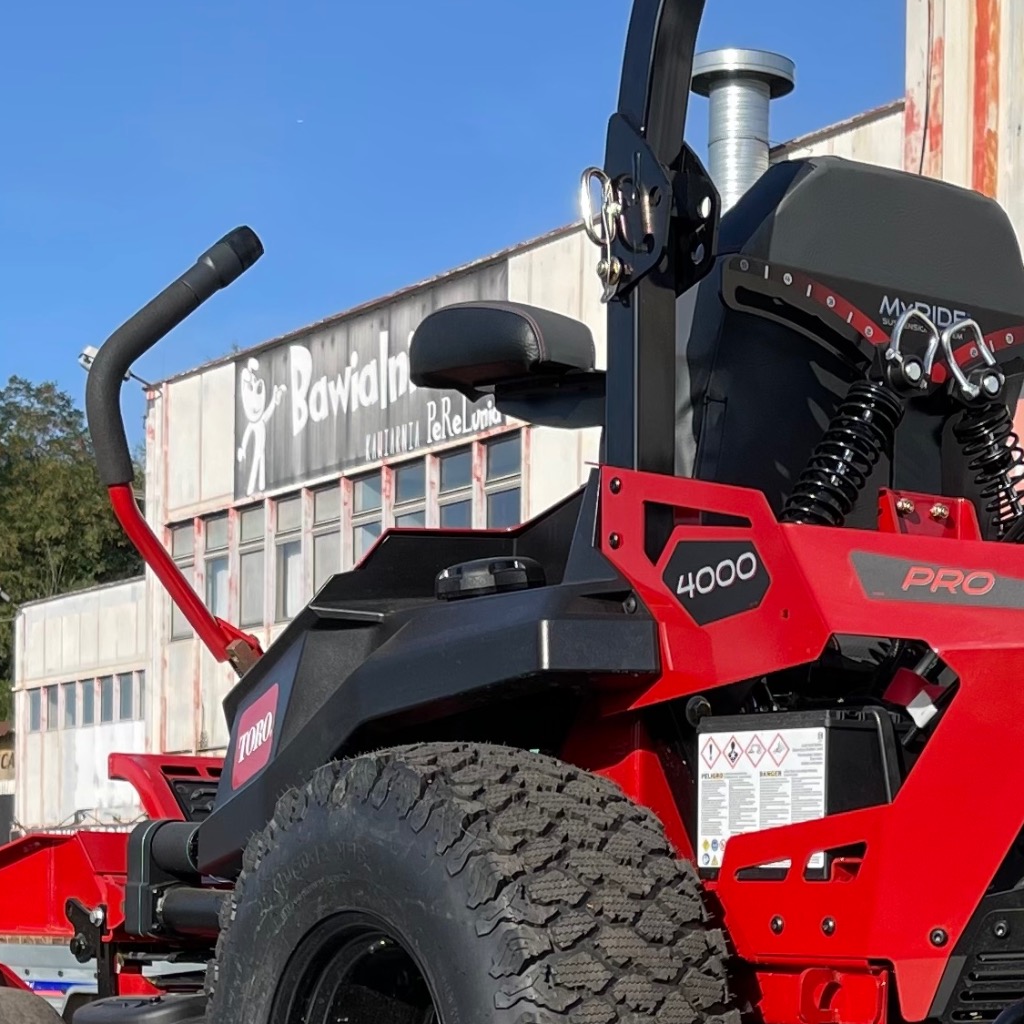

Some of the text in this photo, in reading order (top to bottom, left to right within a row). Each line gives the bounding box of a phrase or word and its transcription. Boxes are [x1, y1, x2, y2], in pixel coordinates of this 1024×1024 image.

[290, 331, 417, 436] Bawialn
[677, 551, 757, 598] 4000
[901, 566, 996, 596] PRO
[238, 711, 273, 763] TORO
